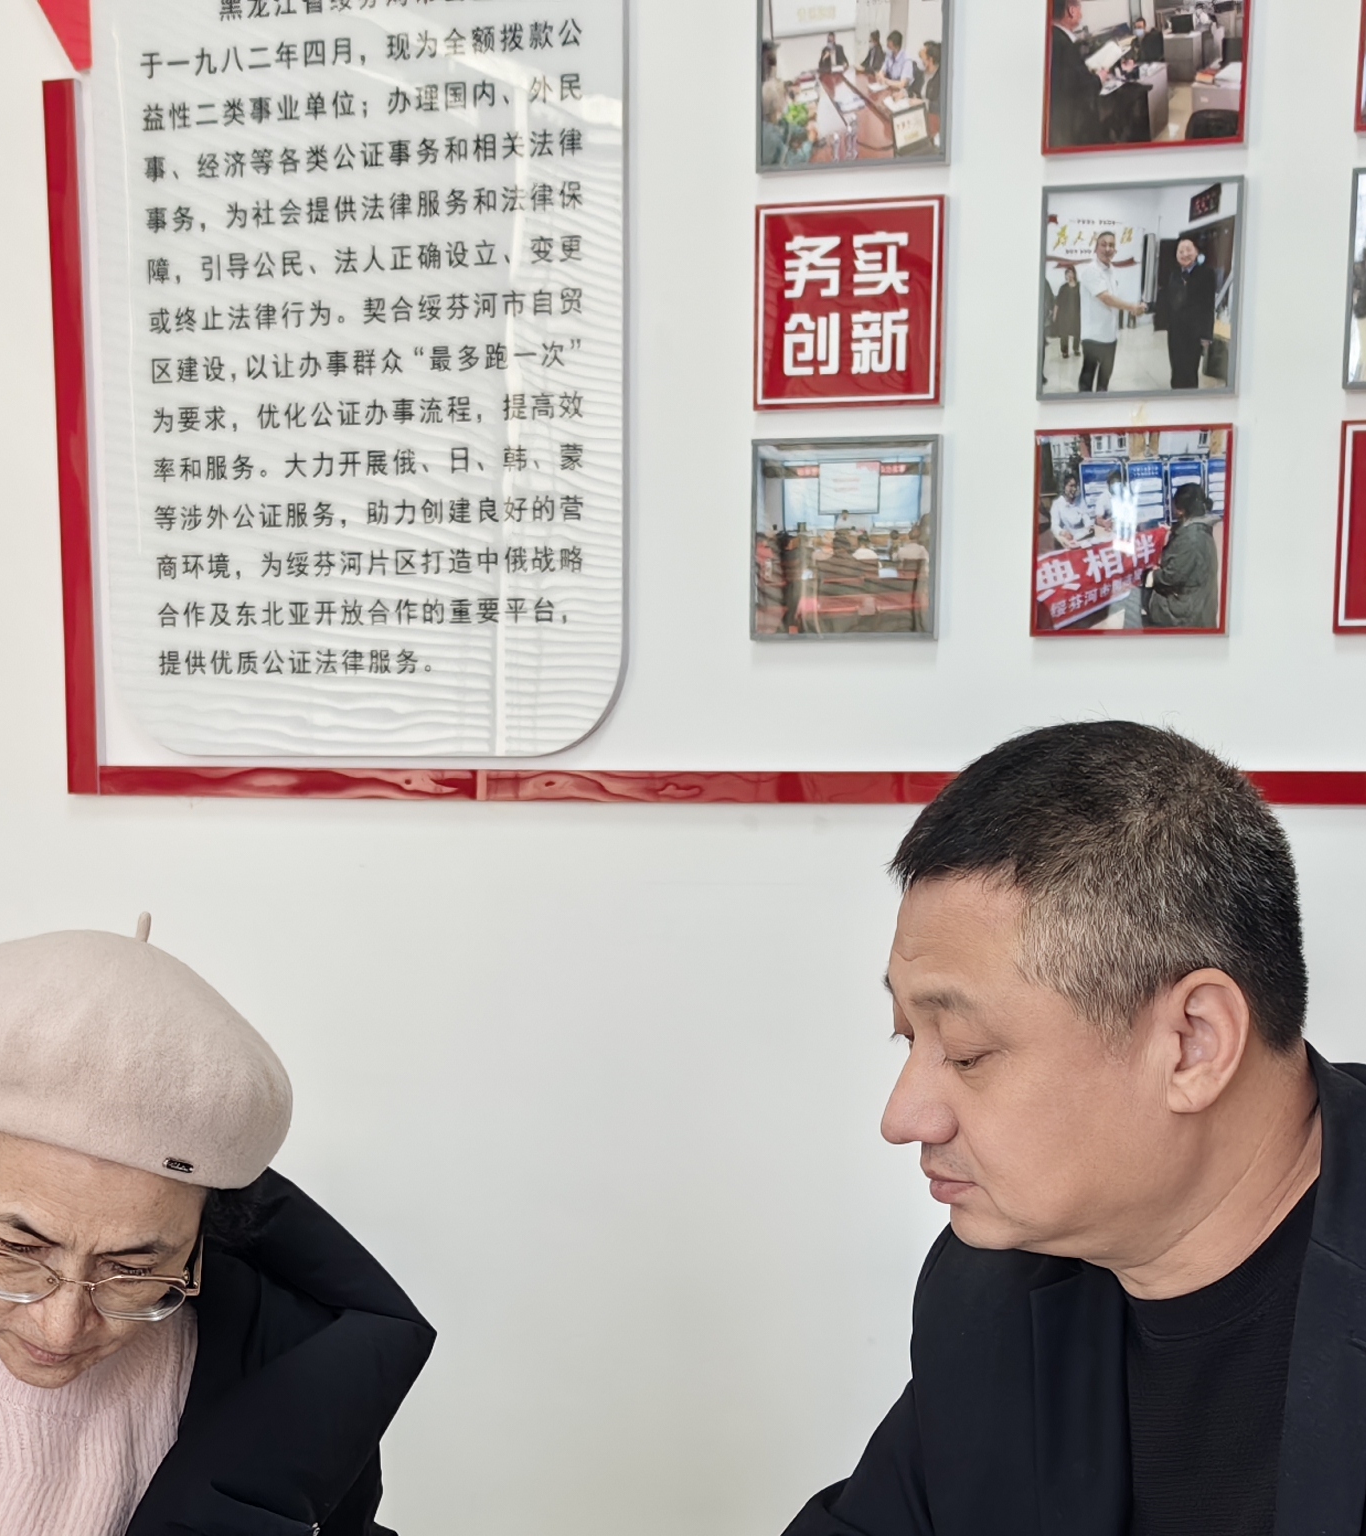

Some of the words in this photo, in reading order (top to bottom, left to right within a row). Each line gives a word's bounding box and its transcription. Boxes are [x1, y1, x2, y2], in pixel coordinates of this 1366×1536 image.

[784, 231, 909, 299] 务实
[783, 309, 908, 376] 创新
[158, 648, 433, 677] 提供优质公证法律服务。
